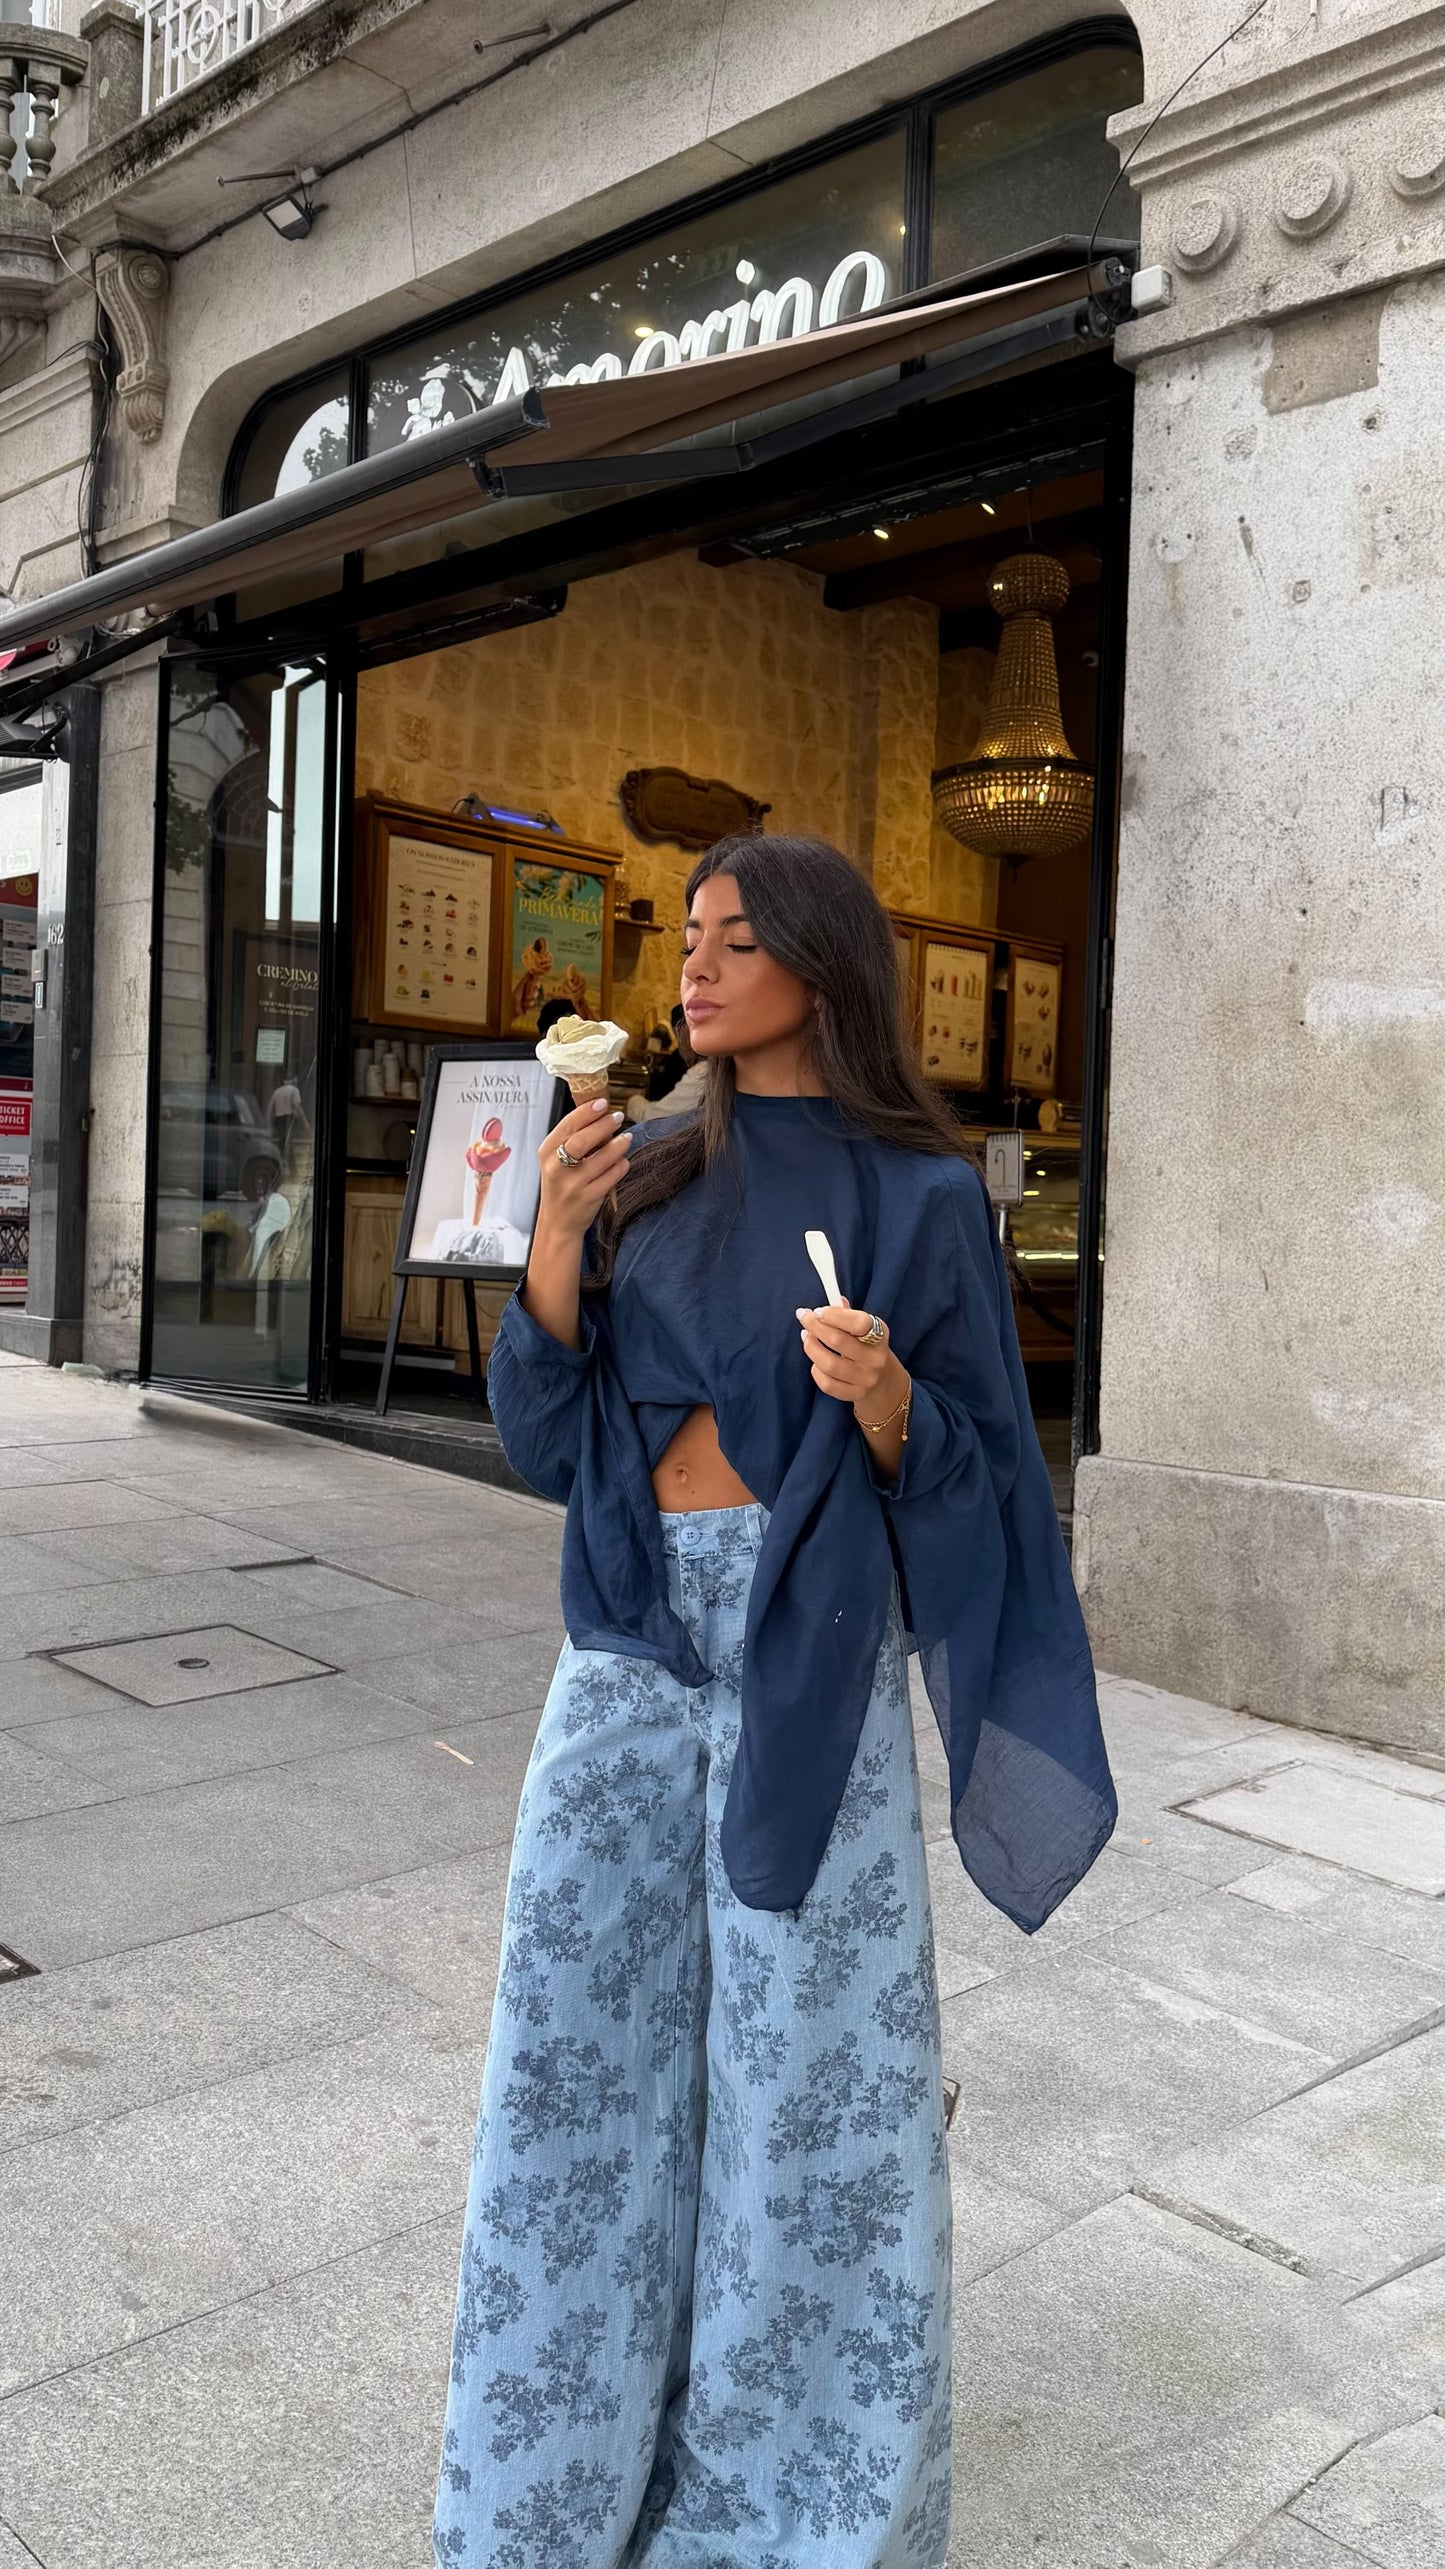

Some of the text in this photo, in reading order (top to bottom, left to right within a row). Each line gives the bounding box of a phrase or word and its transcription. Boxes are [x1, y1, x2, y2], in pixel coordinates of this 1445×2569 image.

[518, 896, 599, 926] PRIMAVERA
[47, 923, 65, 946] 162
[256, 963, 318, 982] CREMINO
[470, 1074, 522, 1088] A NOSSA
[456, 1090, 530, 1104] ASSINATURA
[0, 1115, 25, 1125] OFFICE
